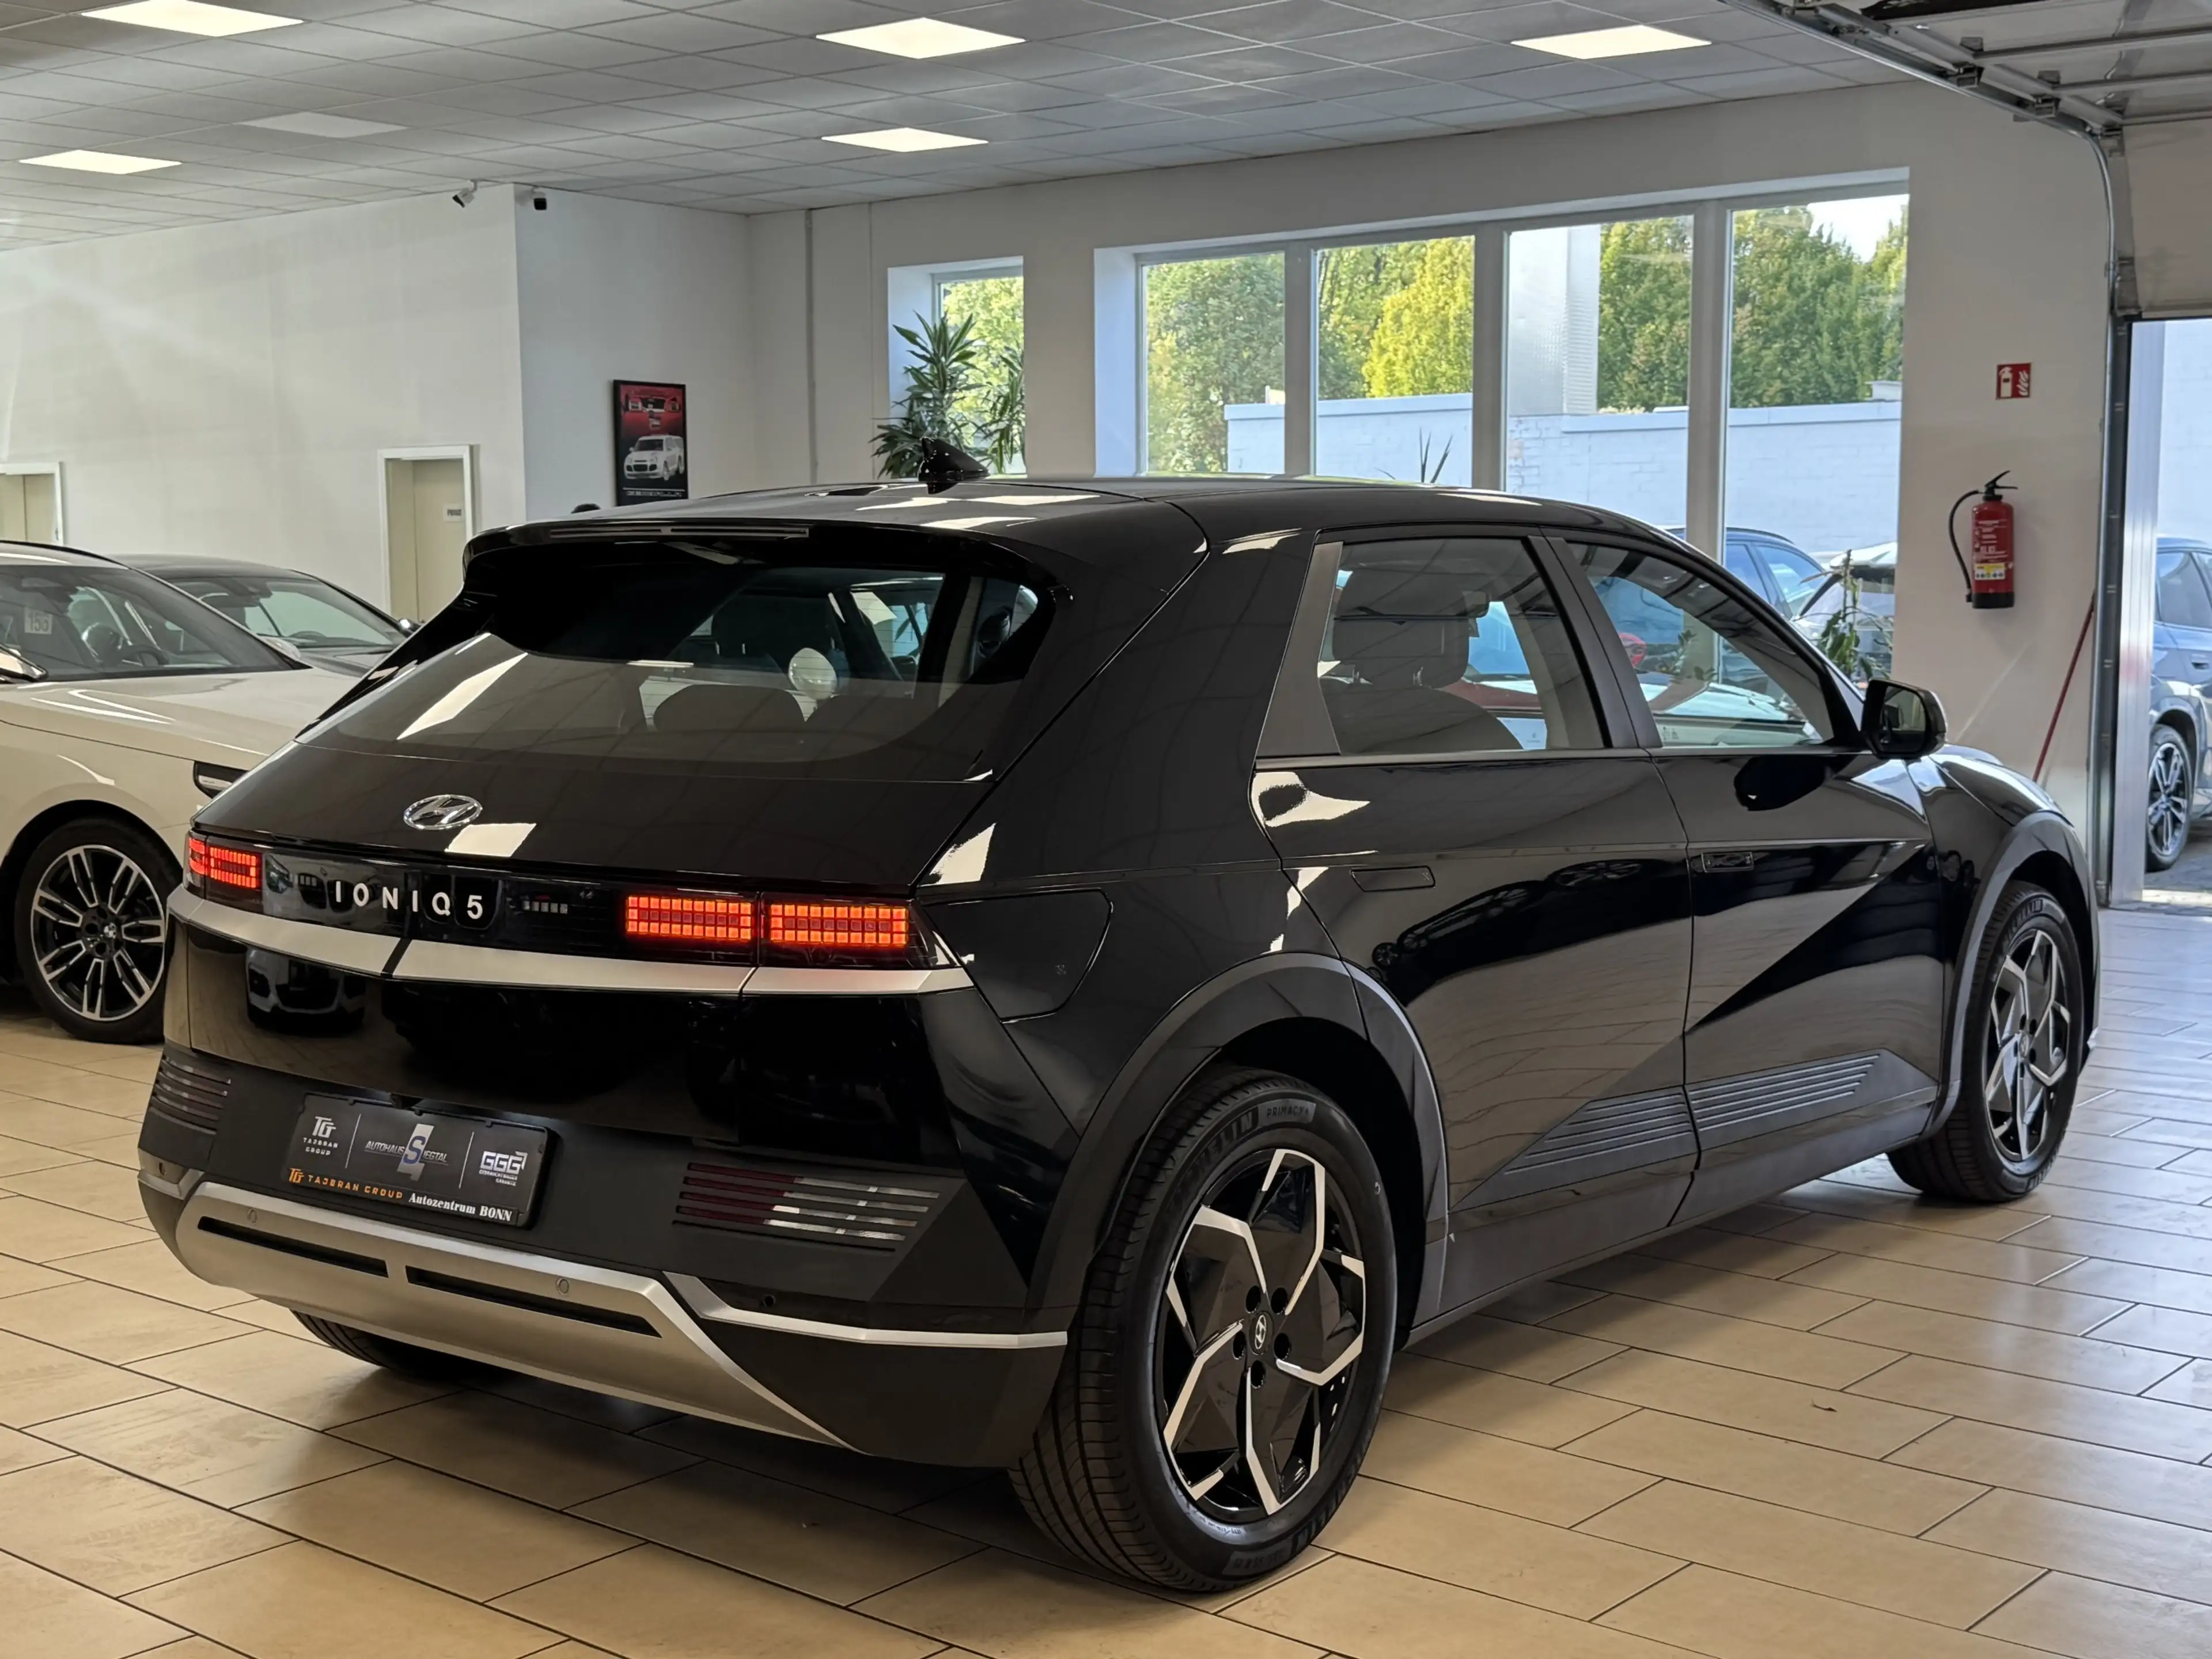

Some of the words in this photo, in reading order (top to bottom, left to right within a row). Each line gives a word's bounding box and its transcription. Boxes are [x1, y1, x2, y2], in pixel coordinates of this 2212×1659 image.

[336, 881, 450, 916] IONIQ
[467, 895, 483, 919] 5
[1266, 1105, 1303, 1118] PRIMACY
[305, 1146, 331, 1156] GROUP
[365, 1141, 406, 1155] AUTOHAUS
[480, 1150, 524, 1175] GGG
[364, 1185, 403, 1199] GROUP
[408, 1192, 475, 1214] Autozentrum
[479, 1205, 512, 1221] BONN
